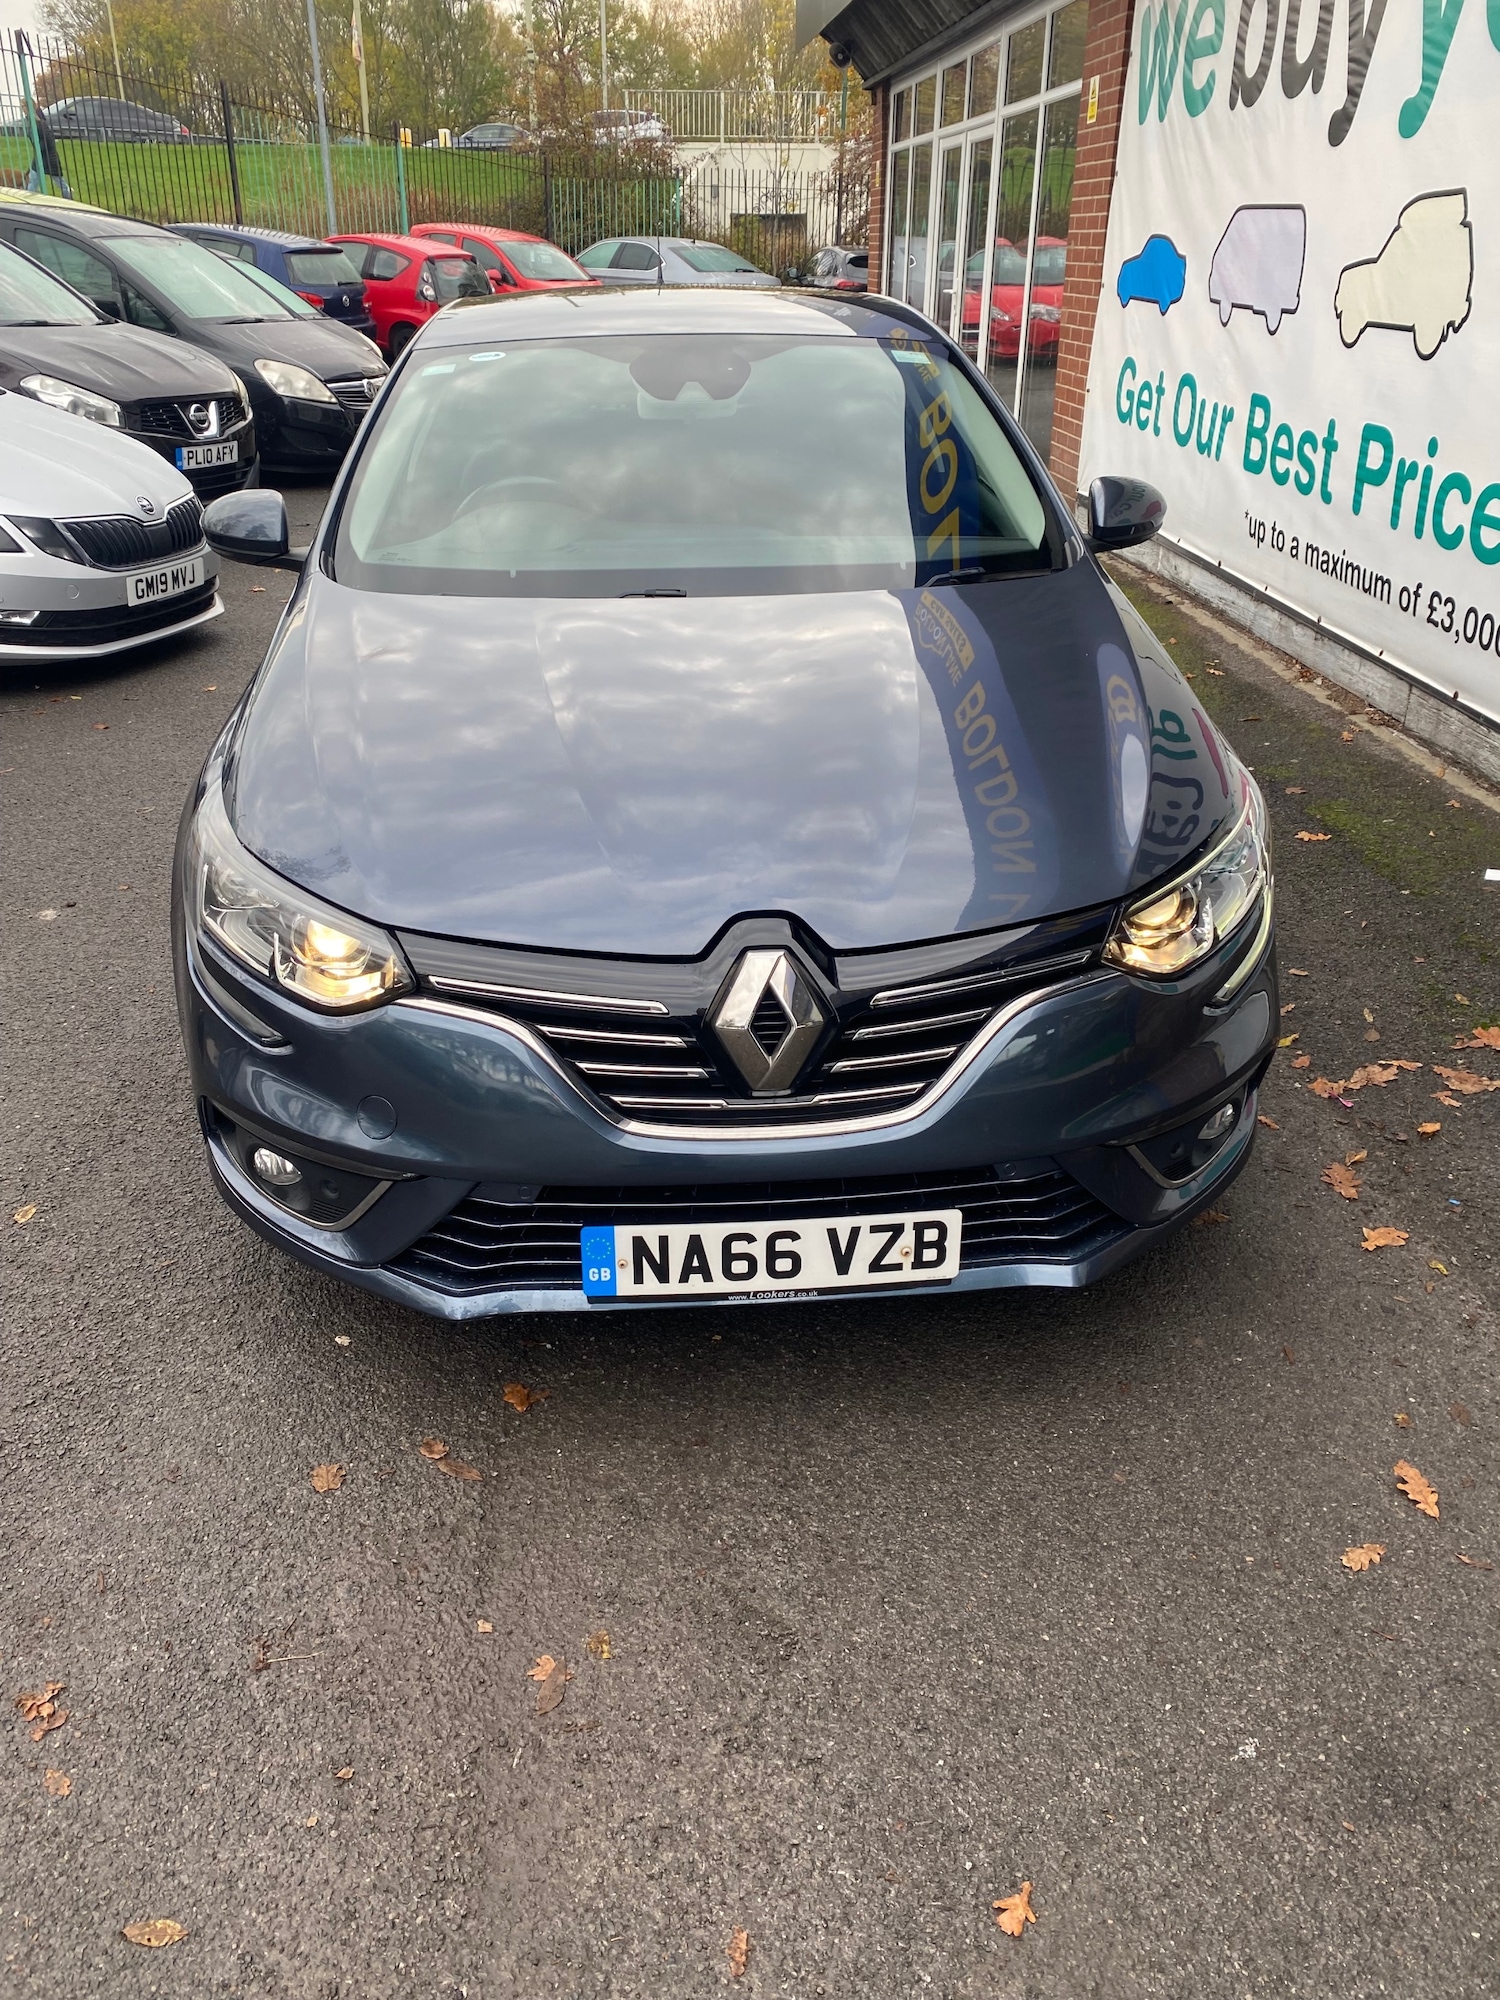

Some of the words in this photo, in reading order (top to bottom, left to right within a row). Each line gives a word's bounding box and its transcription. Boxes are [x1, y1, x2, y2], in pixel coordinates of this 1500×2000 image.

[187, 448, 213, 466] PL10
[216, 445, 234, 462] AFY
[1116, 356, 1166, 437] Get
[1173, 372, 1234, 462] Our
[1243, 392, 1339, 504] Best
[1352, 422, 1500, 565] Price
[135, 572, 168, 599] GM19
[171, 563, 195, 590] MVJ
[1271, 520, 1285, 552] to
[1290, 536, 1299, 560] a
[1304, 541, 1392, 604] maximum
[1399, 582, 1423, 617] of
[632, 1230, 802, 1285] NA66
[826, 1219, 948, 1276] VZB
[588, 1267, 611, 1282] GB
[728, 1290, 819, 1301] www.Lookers.co.uk
